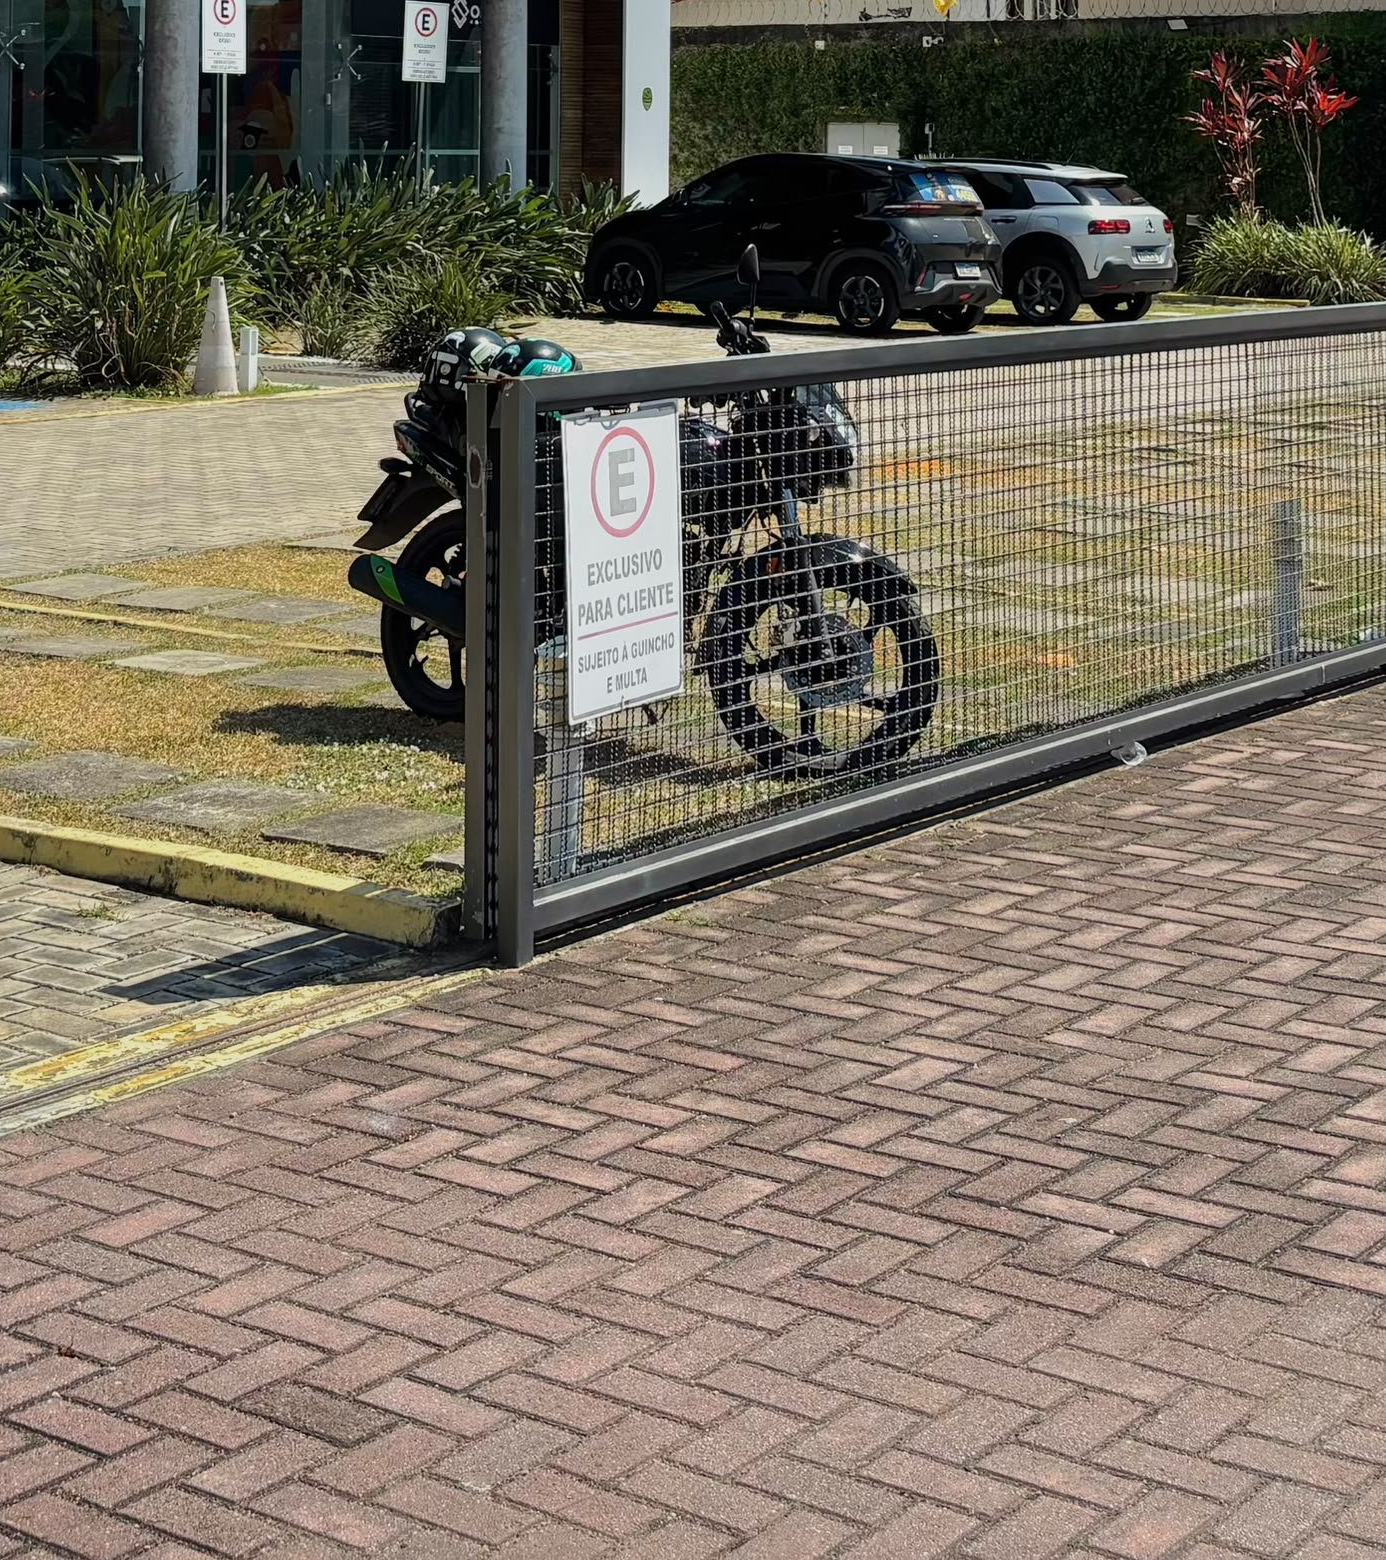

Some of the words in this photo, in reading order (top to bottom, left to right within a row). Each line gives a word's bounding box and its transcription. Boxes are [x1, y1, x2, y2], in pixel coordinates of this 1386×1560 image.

[220, 0, 230, 19] E
[421, 13, 431, 31] E
[608, 447, 637, 517] E
[587, 547, 663, 587] EXCLUSIVO
[577, 596, 614, 628] PARA
[617, 580, 675, 618] CLIENTE
[577, 646, 619, 674] SUJEITO
[630, 630, 676, 658] GUINCHO
[606, 677, 613, 696] E
[614, 667, 649, 692] MULTA
